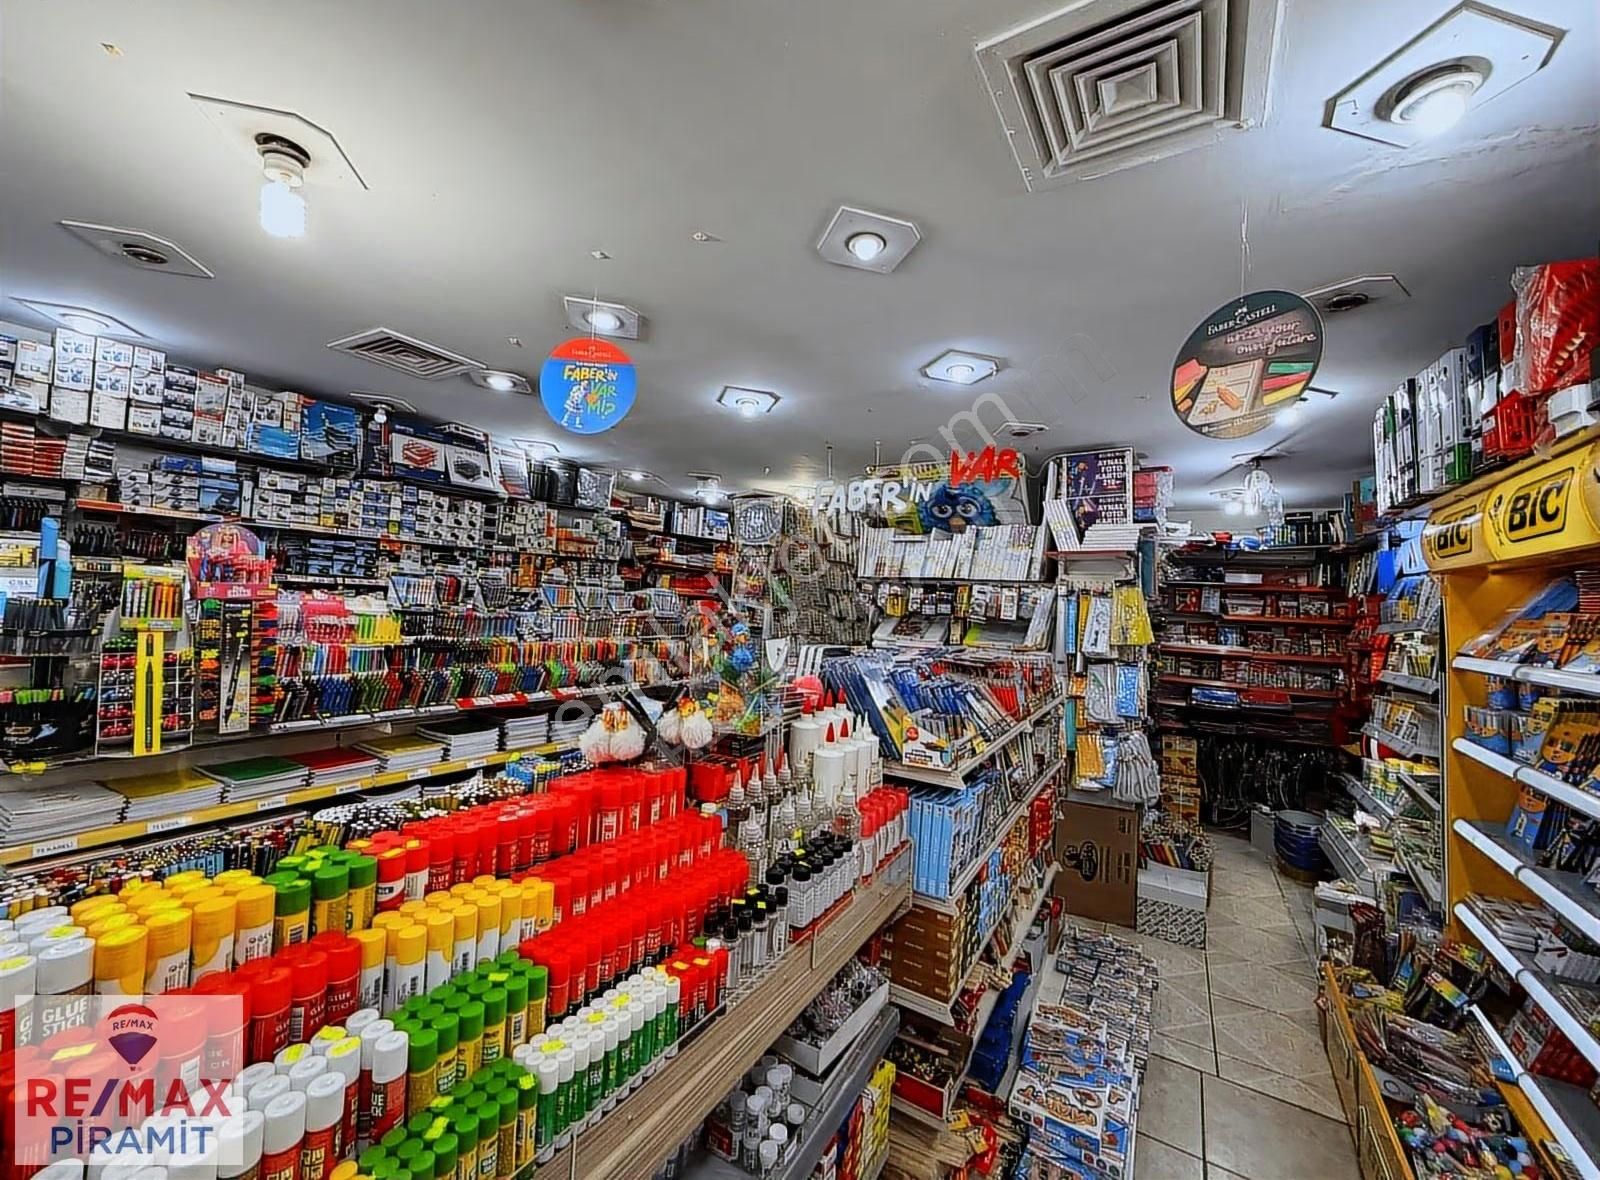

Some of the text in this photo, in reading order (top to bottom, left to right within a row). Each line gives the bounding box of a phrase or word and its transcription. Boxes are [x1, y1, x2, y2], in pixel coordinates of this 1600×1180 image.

[591, 380, 617, 397] VAR
[949, 443, 1021, 487] VAR
[41, 997, 88, 1024] GLUE
[42, 1010, 86, 1038] STICK
